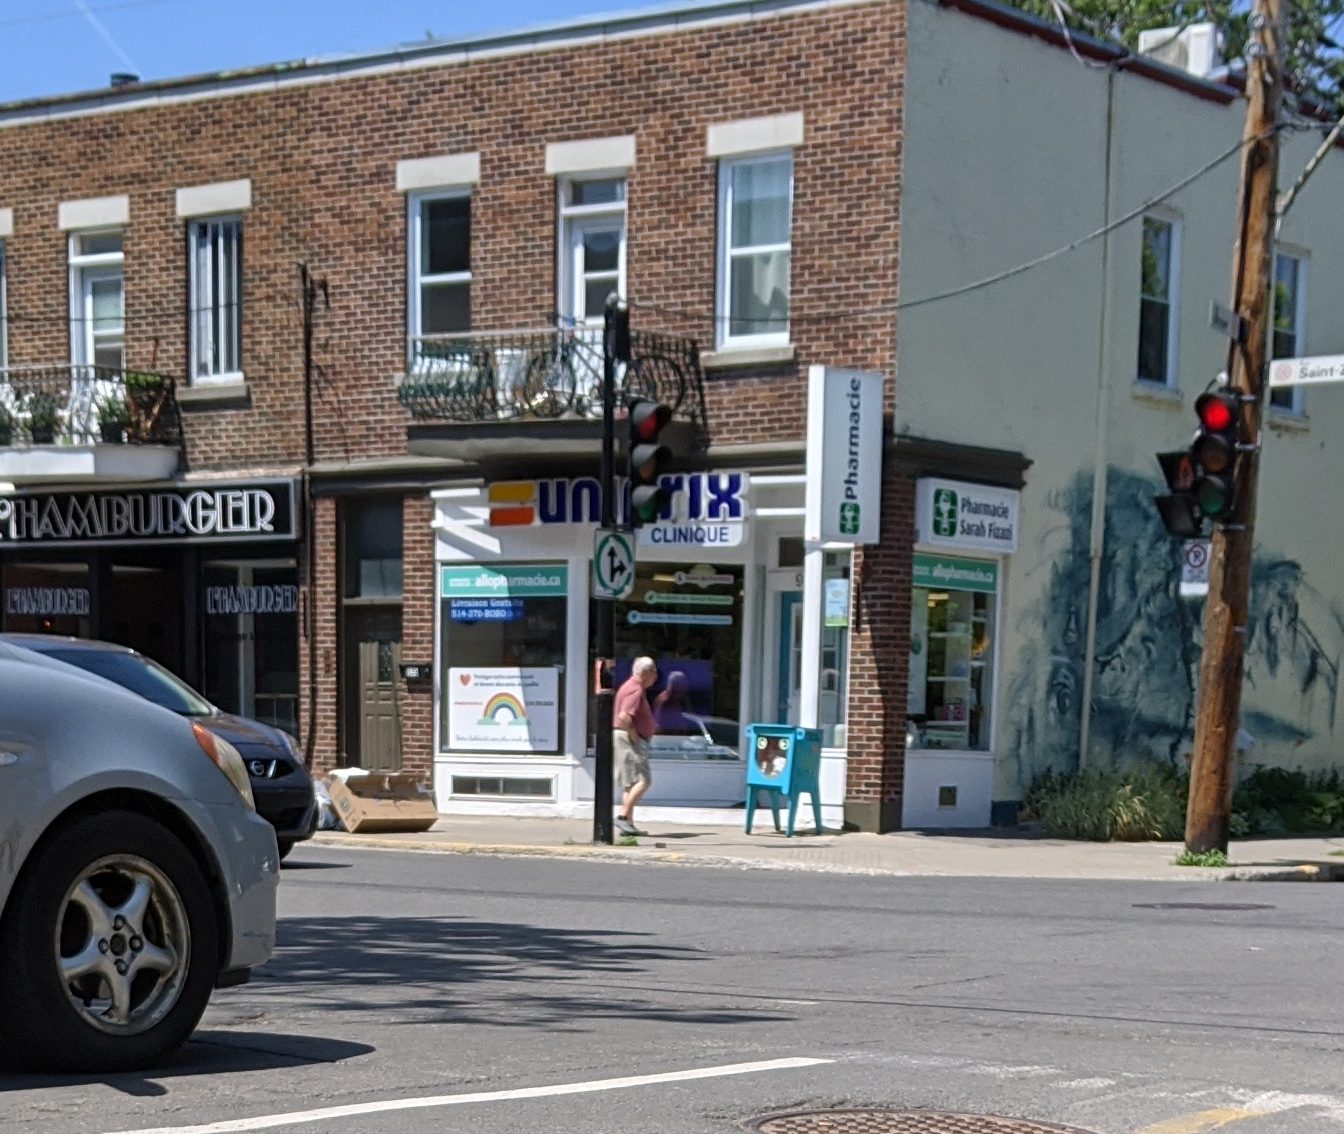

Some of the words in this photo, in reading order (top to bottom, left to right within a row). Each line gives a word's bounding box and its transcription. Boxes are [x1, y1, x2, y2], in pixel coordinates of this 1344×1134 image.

[843, 377, 862, 500] Pharmacie
[961, 496, 1009, 519] Pharmacie
[650, 526, 730, 544] CLINIQUE
[475, 573, 561, 590] allopharmacie.ca
